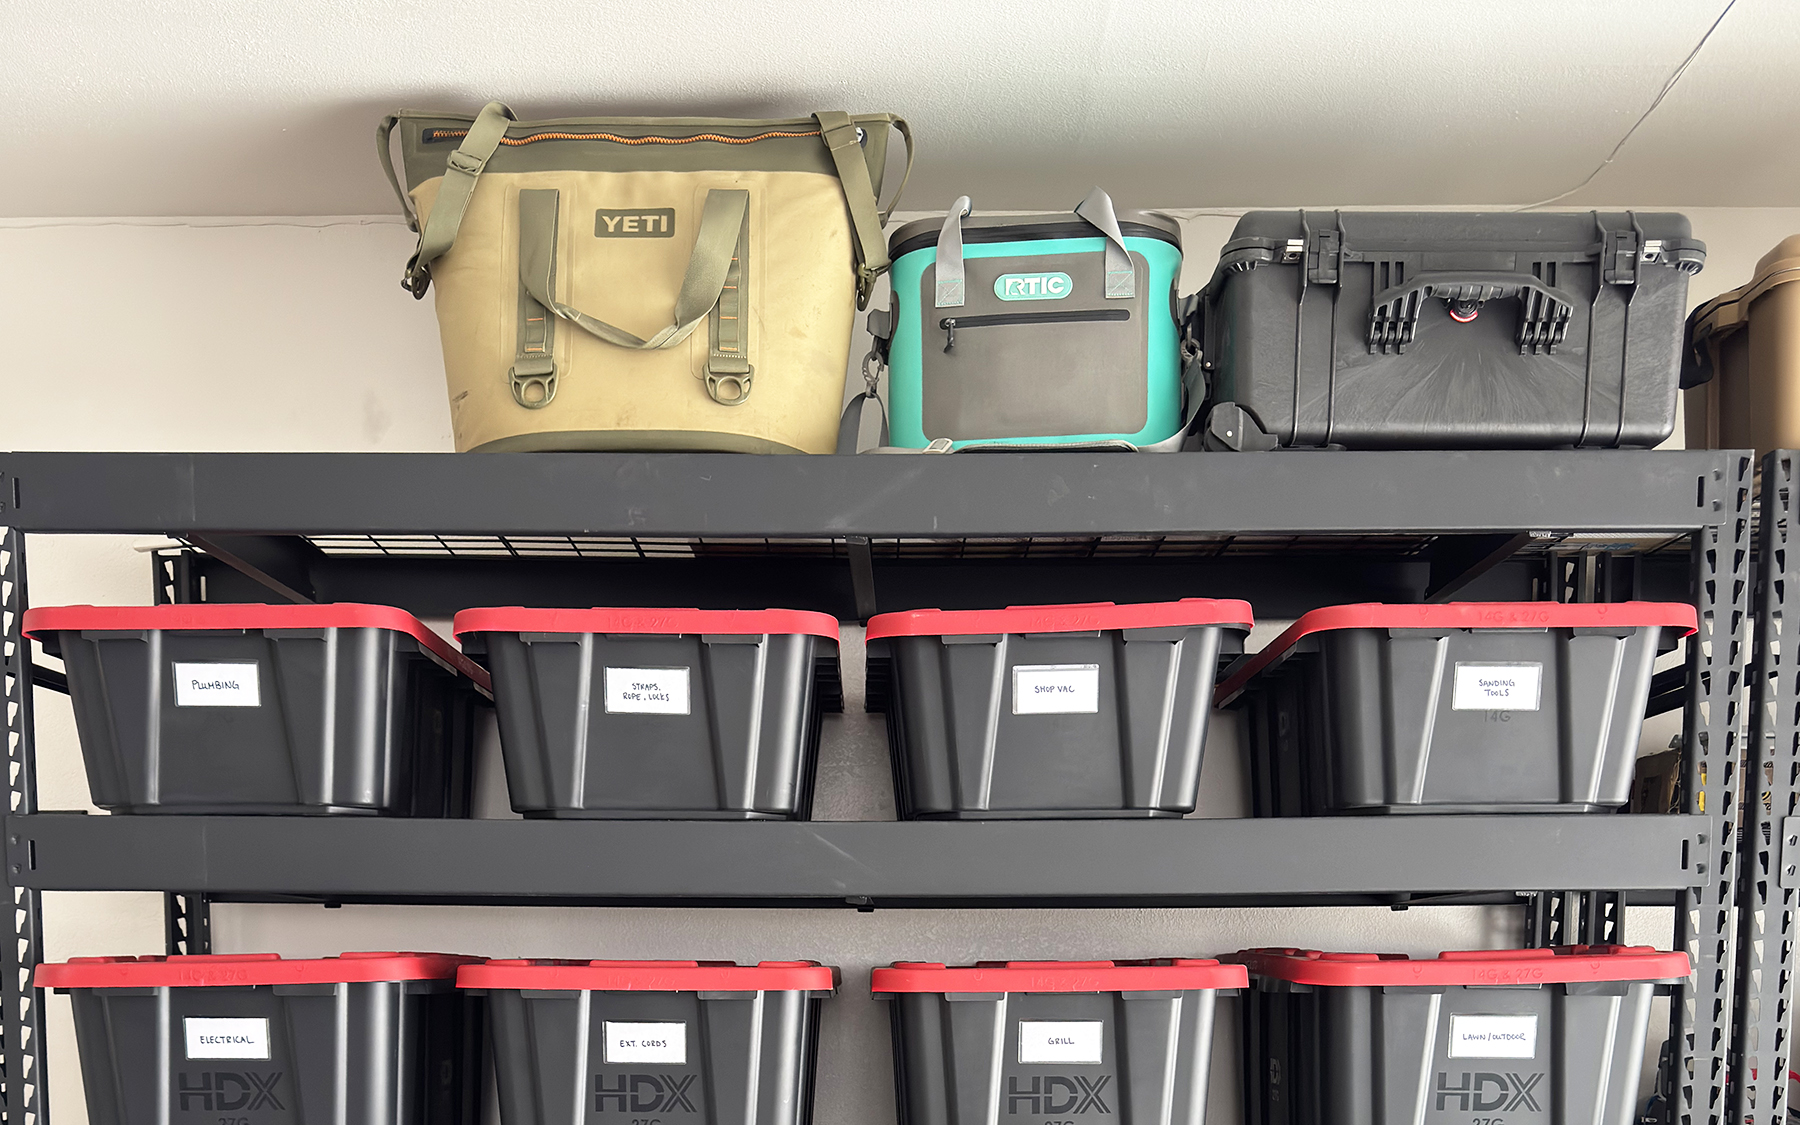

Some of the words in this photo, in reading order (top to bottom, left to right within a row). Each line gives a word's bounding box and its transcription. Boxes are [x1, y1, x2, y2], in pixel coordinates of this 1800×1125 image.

[601, 215, 668, 233] YETI
[1004, 276, 1065, 296] RTIC
[1479, 611, 1503, 622] 14G
[191, 679, 240, 691] PLUMBING
[1478, 678, 1516, 688] SANDING
[1034, 685, 1056, 694] SHOP
[1056, 685, 1076, 693] VAC
[1483, 688, 1510, 697] TOOLS
[1483, 710, 1512, 723] 14G
[199, 1035, 255, 1045] ELECTRICAL
[641, 1039, 667, 1048] CORDS
[1047, 1037, 1075, 1045] GRILL
[178, 1072, 286, 1111] HDX
[594, 1074, 698, 1113] HDX
[1007, 1075, 1112, 1115] HDX
[1435, 1071, 1546, 1112] HDX
